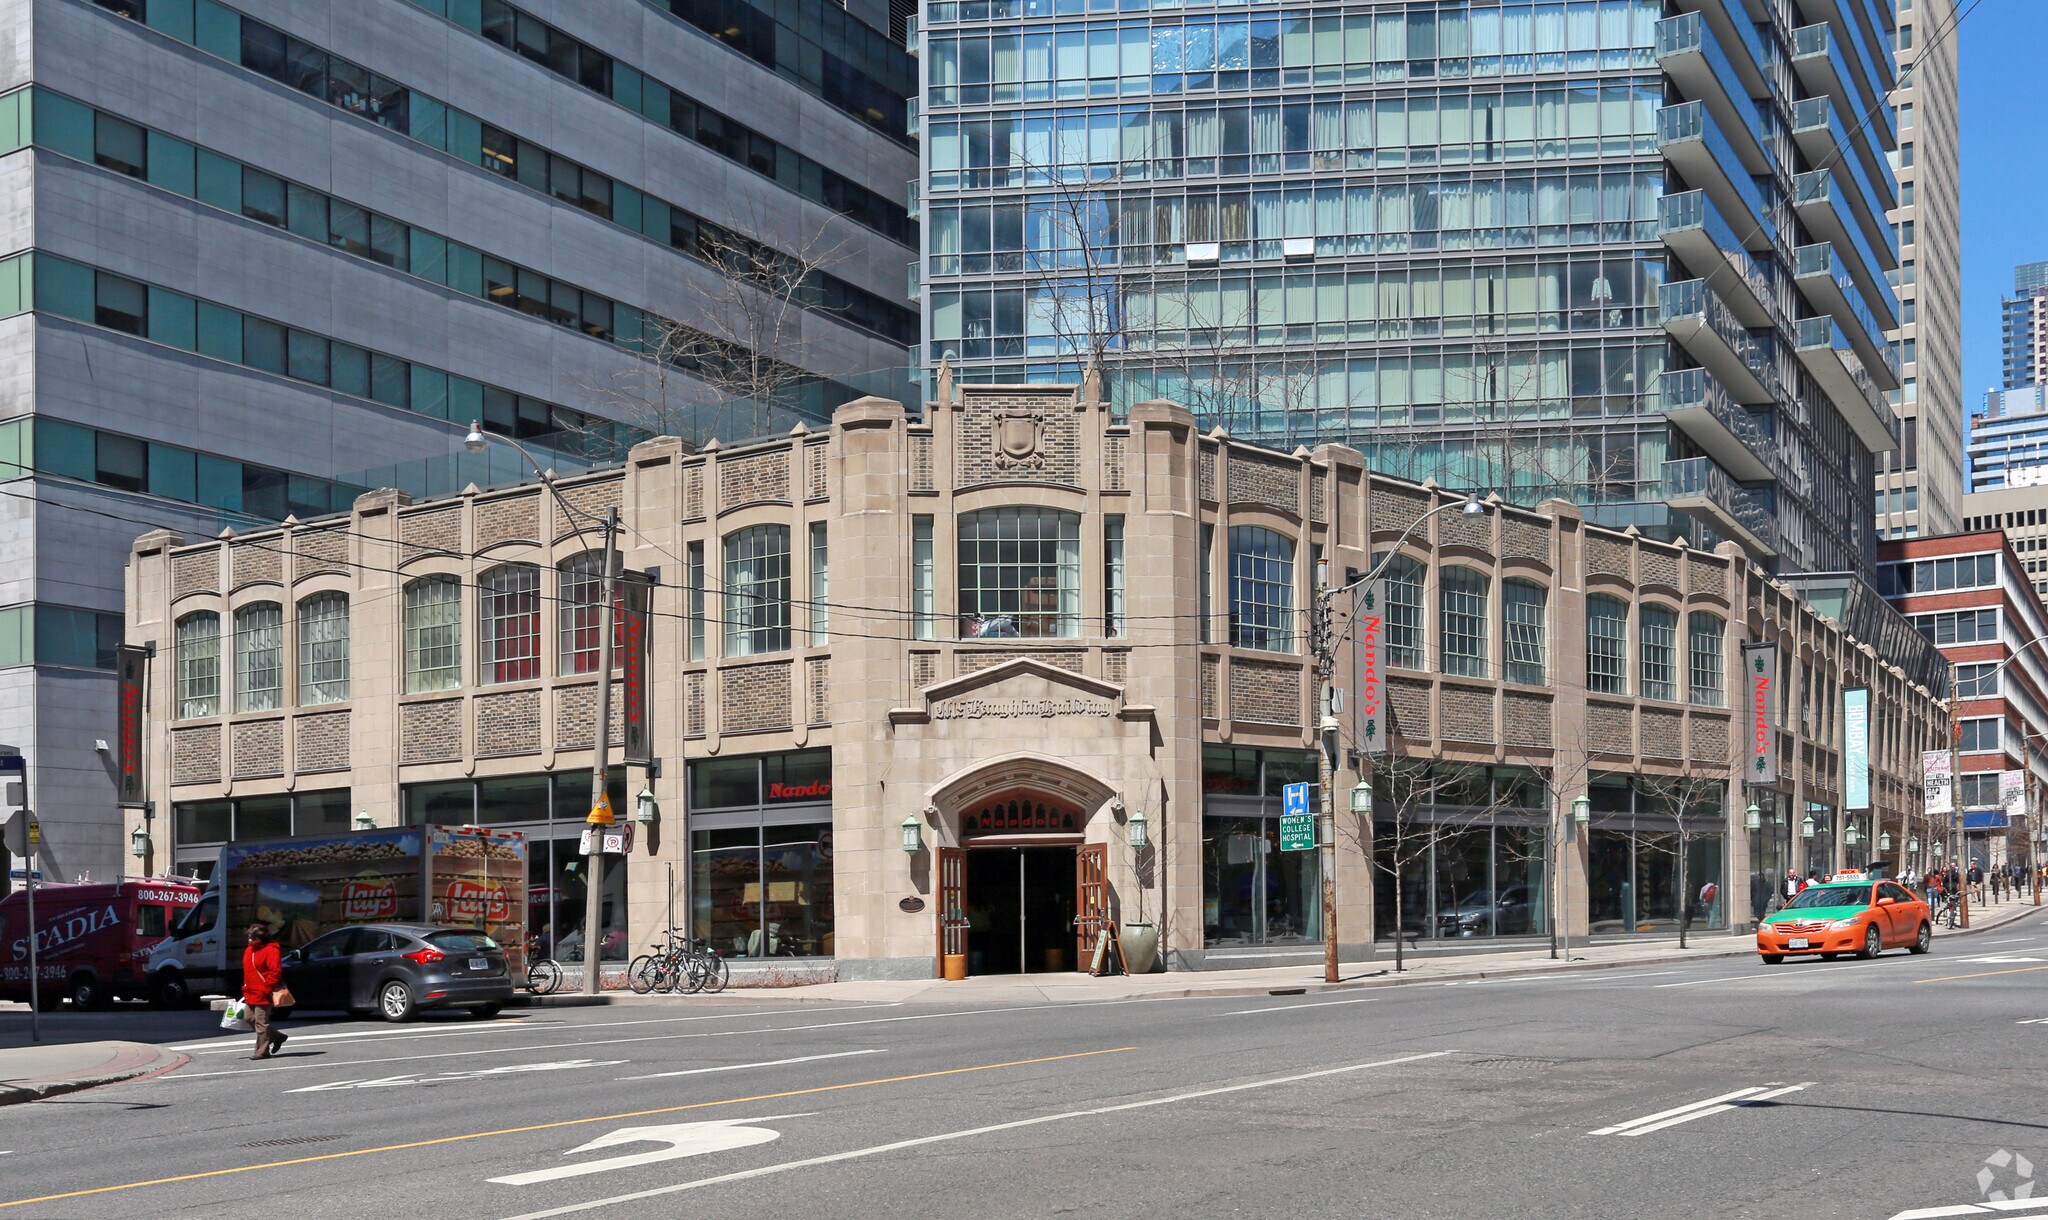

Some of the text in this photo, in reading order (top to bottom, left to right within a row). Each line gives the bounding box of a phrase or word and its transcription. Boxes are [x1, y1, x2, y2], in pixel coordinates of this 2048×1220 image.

[627, 616, 642, 722] Nando's
[1364, 615, 1381, 716] Nando's
[1040, 700, 1112, 718] Building
[1754, 675, 1771, 754] Nando's
[122, 683, 139, 773] Nando's
[1848, 704, 1865, 756] BOMBAY
[1287, 785, 1304, 806] H
[1282, 815, 1312, 825] WOMEN'S
[1282, 824, 1311, 833] COLLEGE
[1282, 833, 1312, 842] HOSPITAL
[138, 889, 199, 904] 800-267-3946
[345, 883, 393, 917] Lay's
[450, 883, 504, 919] Lay's
[12, 904, 121, 961] STADIA
